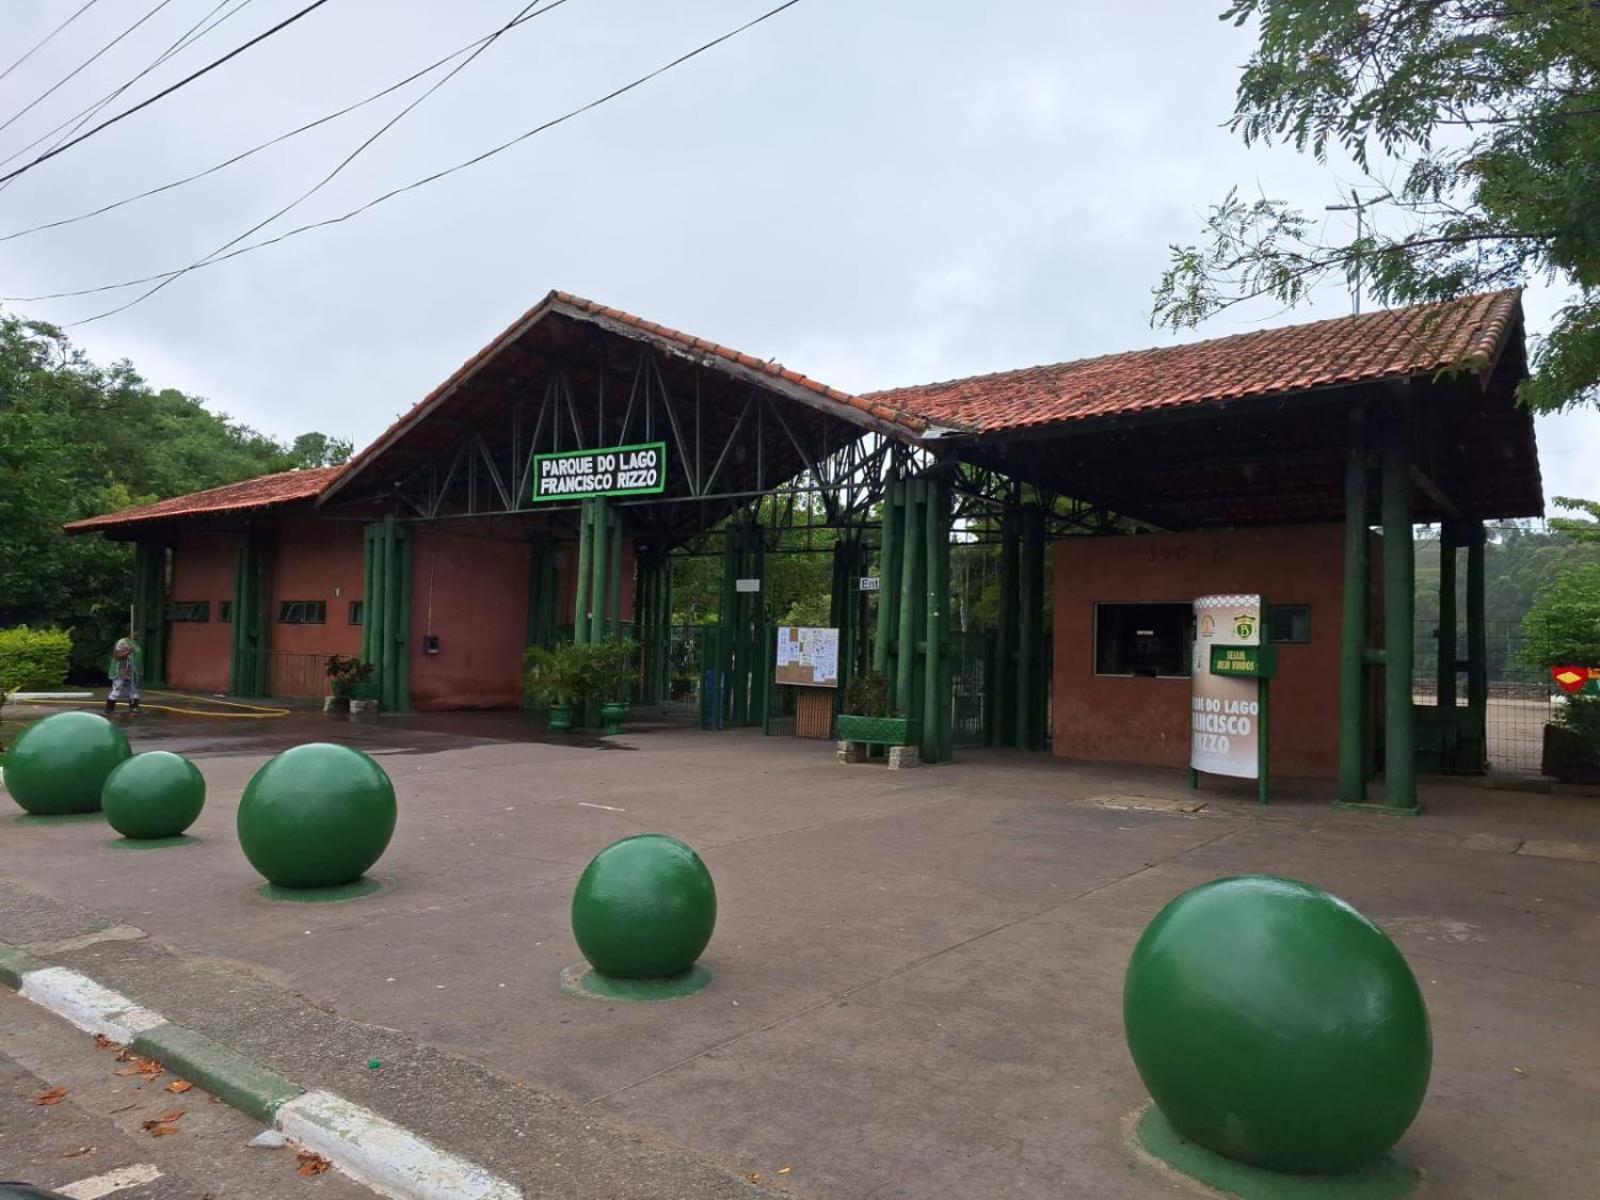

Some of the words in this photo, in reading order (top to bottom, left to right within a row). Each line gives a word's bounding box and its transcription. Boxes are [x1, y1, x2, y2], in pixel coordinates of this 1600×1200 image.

[542, 456, 593, 477] PARQUE
[597, 454, 616, 472] DO
[620, 450, 656, 471] LAGO
[540, 473, 613, 494] FRANCISCO
[617, 469, 657, 488] RIZZO
[1206, 698, 1220, 713] DO
[1224, 699, 1259, 715] LAGO
